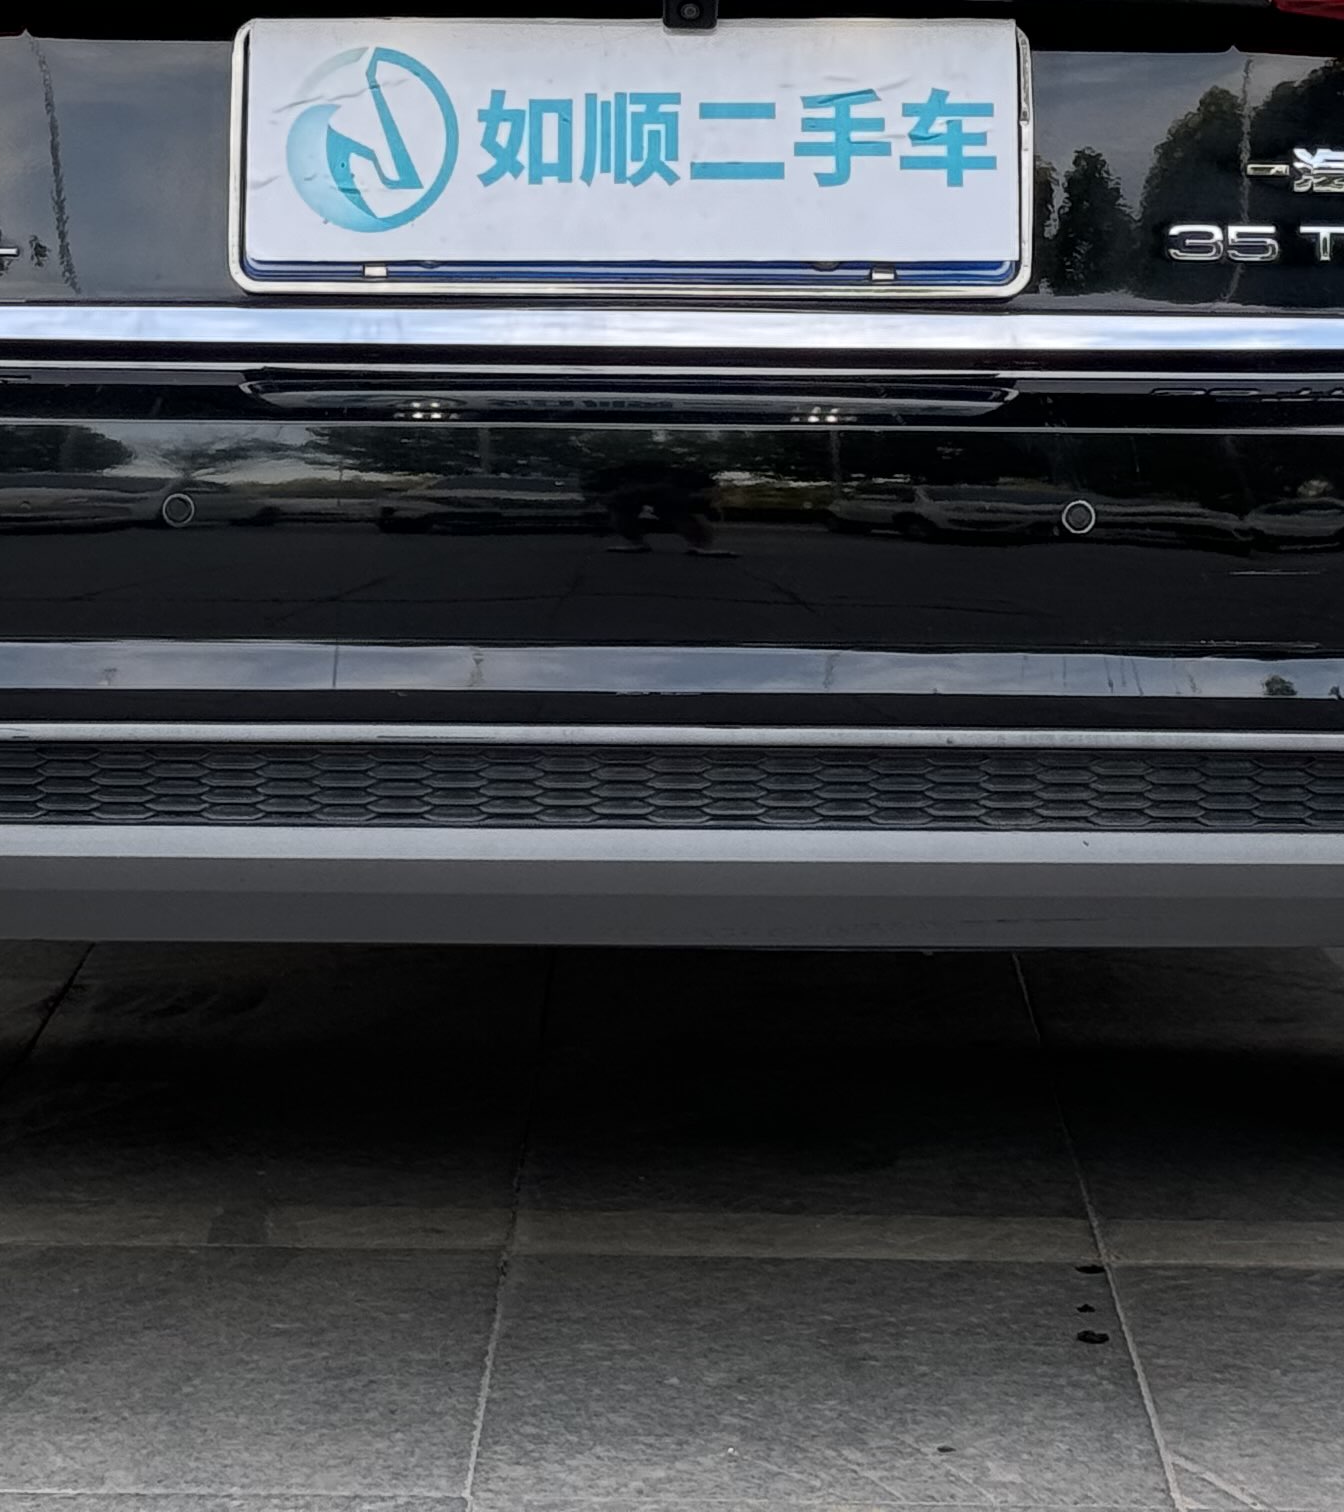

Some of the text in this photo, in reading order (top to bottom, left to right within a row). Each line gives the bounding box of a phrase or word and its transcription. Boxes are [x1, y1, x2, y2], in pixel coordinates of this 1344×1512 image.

[477, 87, 998, 189] 如顺二手车
[1167, 223, 1280, 263] 35
